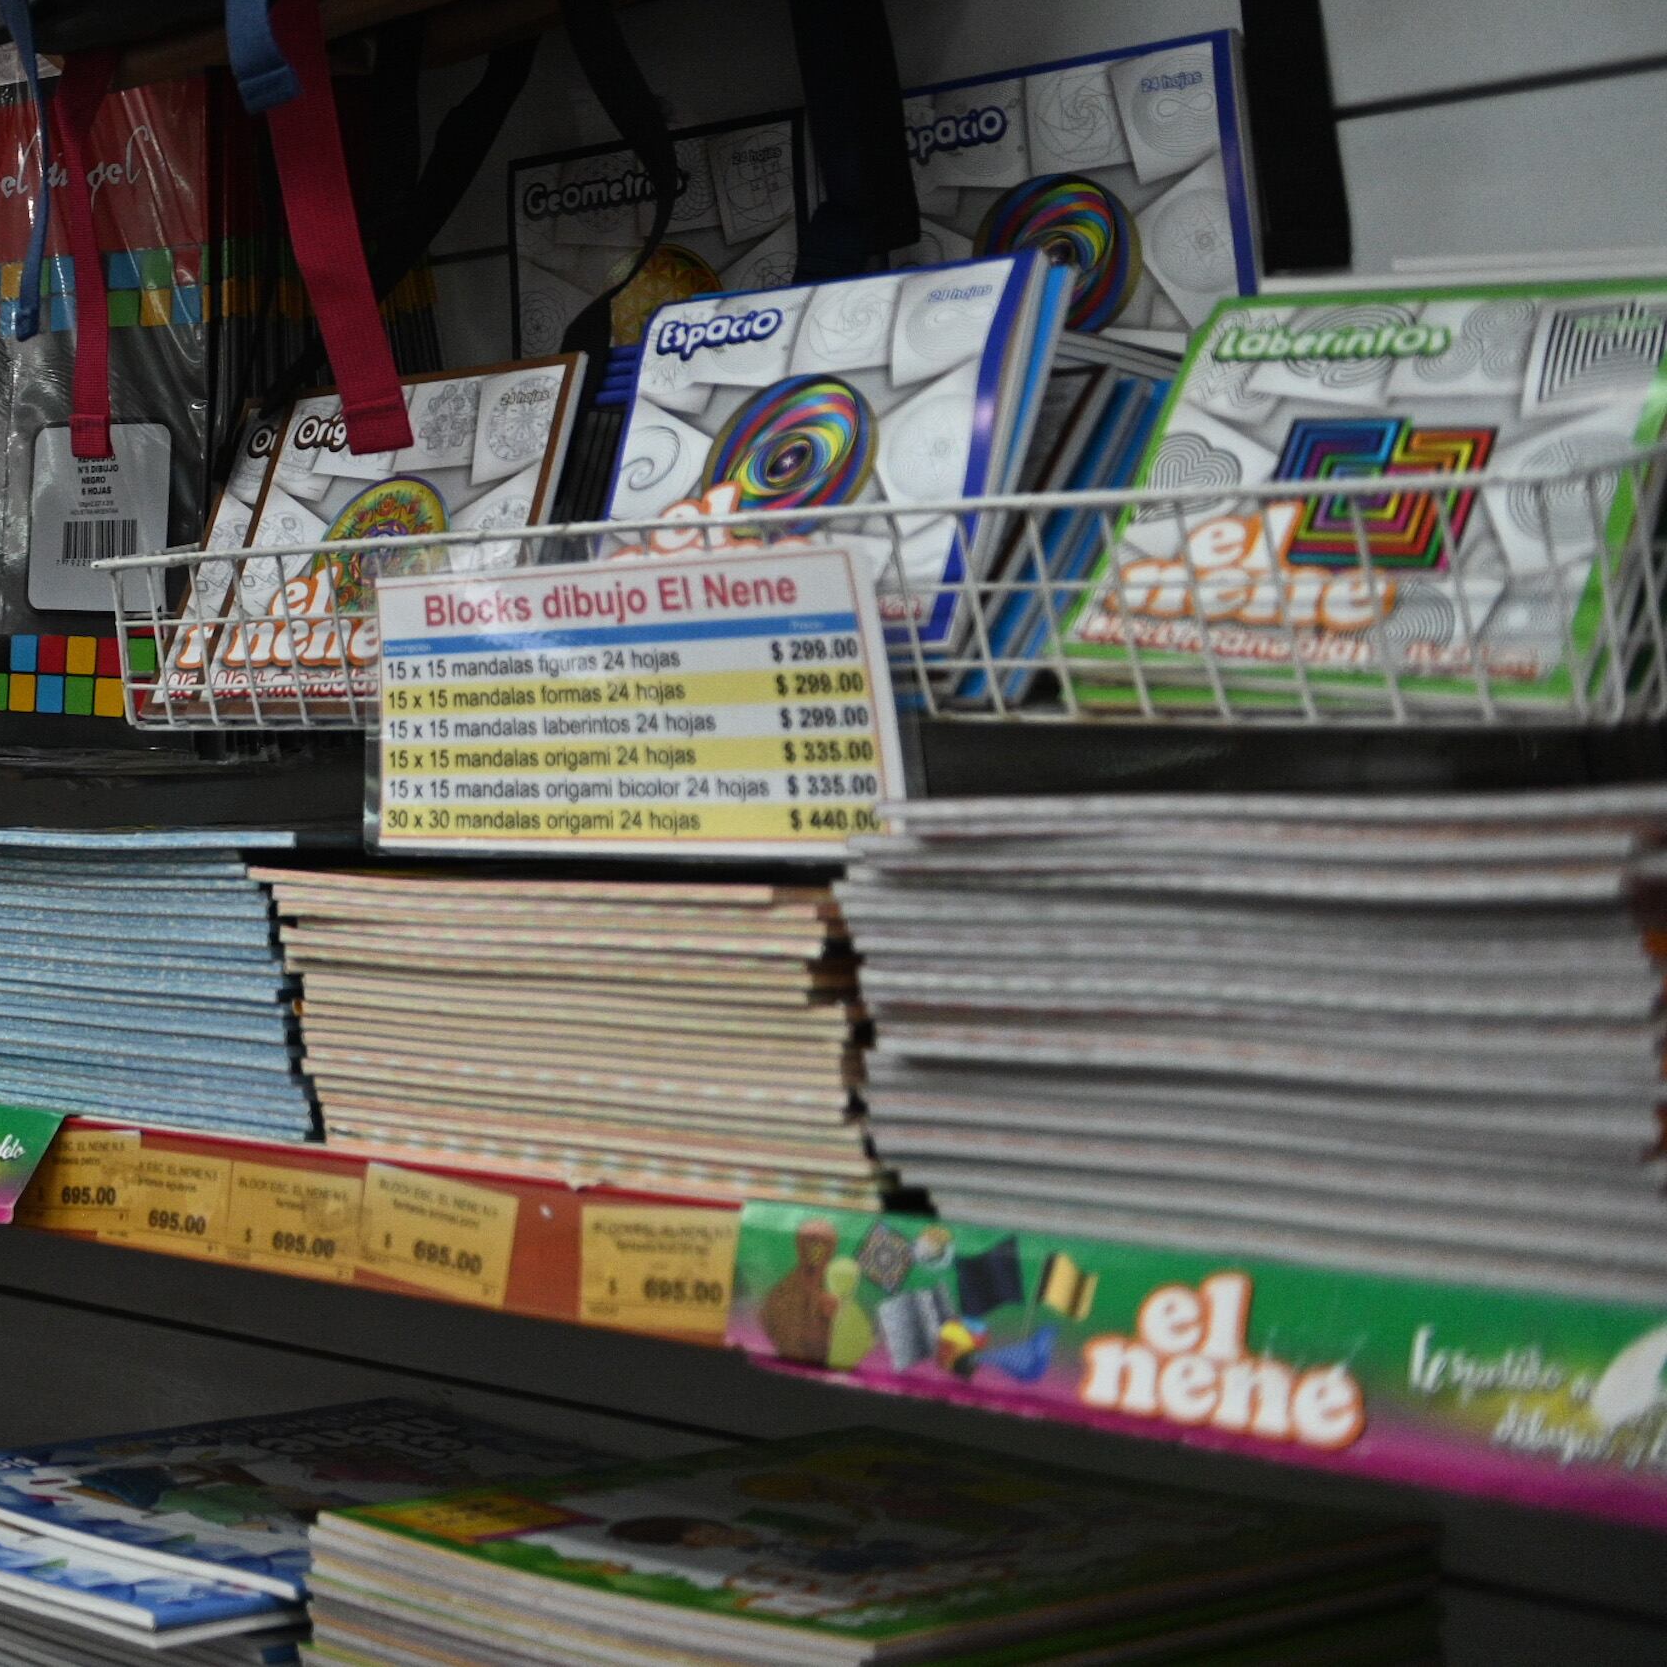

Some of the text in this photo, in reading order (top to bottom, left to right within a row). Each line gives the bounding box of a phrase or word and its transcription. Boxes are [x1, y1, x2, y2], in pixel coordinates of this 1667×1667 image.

[657, 307, 783, 361] Espacio
[1216, 321, 1452, 361] Laberintos
[82, 477, 106, 485] NEGRO
[91, 465, 119, 474] DIBUJO
[88, 486, 112, 495] HOJAS
[270, 564, 342, 619] el
[425, 573, 798, 627] Blocks dibujo El Nene
[387, 661, 407, 680] 15
[411, 667, 421, 679] x
[428, 659, 447, 678] 15
[452, 656, 534, 677] mandalas
[604, 651, 624, 671] 24
[632, 649, 681, 673] hojas
[771, 640, 783, 663] $
[388, 690, 407, 709] 15
[412, 696, 422, 708] x
[429, 689, 448, 708] 15
[453, 686, 535, 707] mandalas
[541, 683, 602, 705] formas
[607, 682, 629, 702] 24
[636, 681, 686, 705] hojas
[389, 720, 408, 739] 15
[413, 726, 423, 738] x
[430, 719, 449, 738] 15
[454, 716, 537, 737] mandalas
[543, 714, 630, 735] laberintos
[636, 713, 659, 733] 24
[666, 711, 717, 737] hojas
[389, 740, 874, 772] 15 x 15 mandalas origami 24 hojas 335.00
[389, 774, 877, 803] 15 x 15 mandalas origami bicolor 24 hojas 335.00
[387, 808, 881, 835] 30 x 30 mandalas origami 24 hojas 440.00
[62, 1186, 116, 1207] 695.00
[148, 1209, 206, 1235] 695.00
[273, 1231, 335, 1258] 695.00
[413, 1238, 483, 1275] 695.00
[643, 1276, 724, 1305] 695.00
[1141, 1276, 1251, 1361] el
[1087, 1337, 1361, 1440] nene
